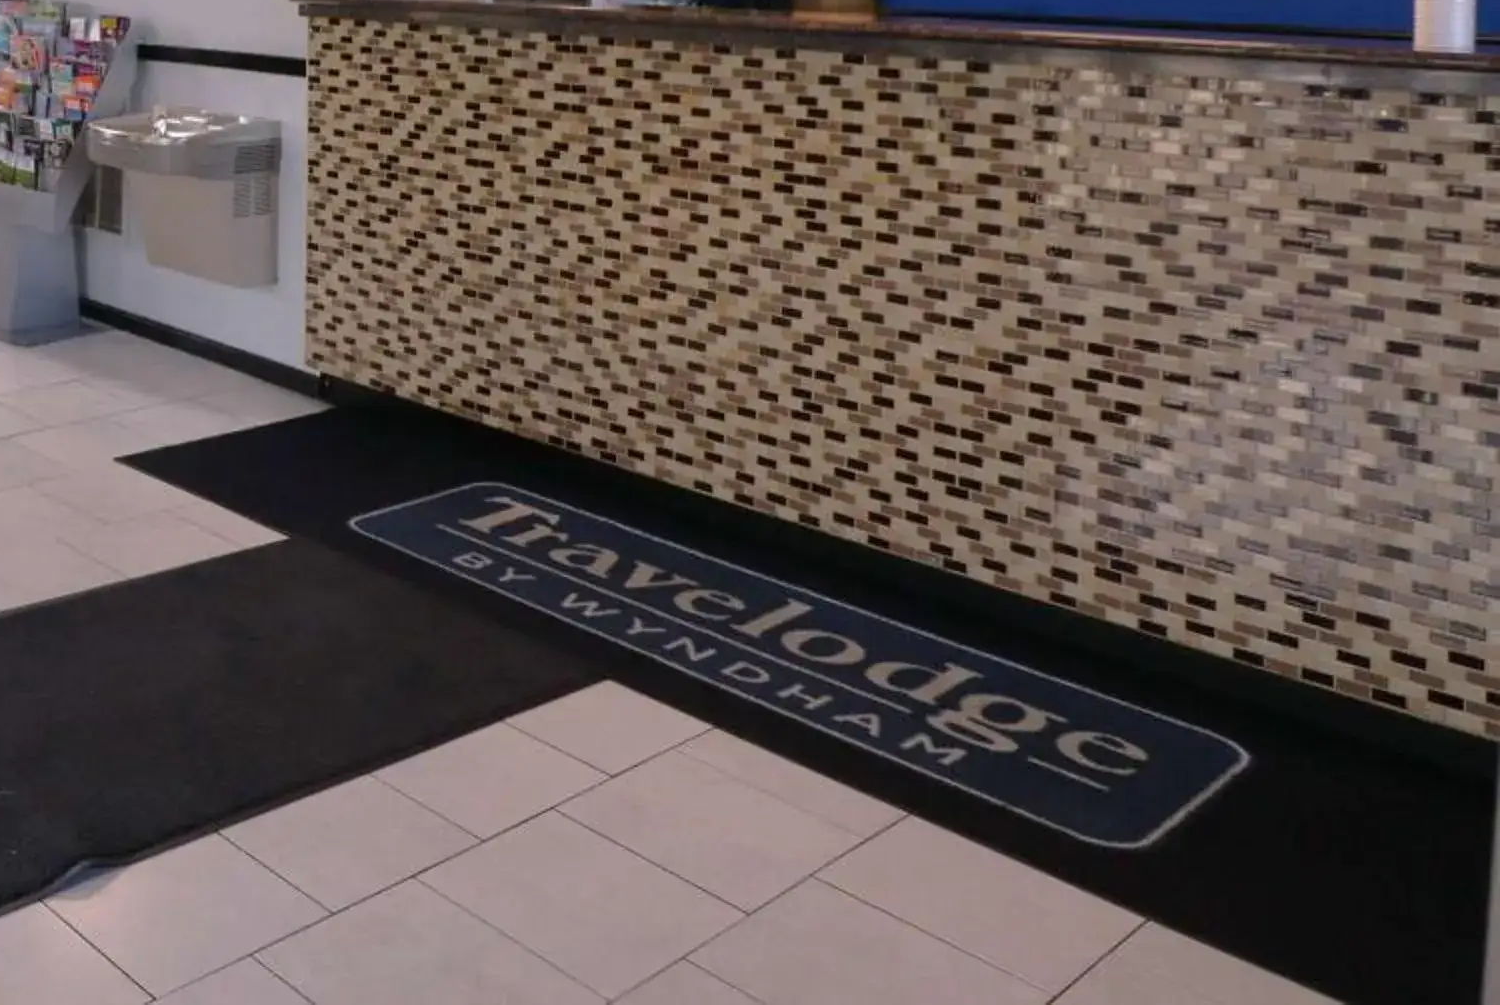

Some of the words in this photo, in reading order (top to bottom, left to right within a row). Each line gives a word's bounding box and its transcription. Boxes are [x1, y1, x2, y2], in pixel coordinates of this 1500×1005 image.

[452, 550, 537, 583] BY
[559, 592, 968, 766] WYNDHAM
[457, 495, 1149, 776] Travelodge
